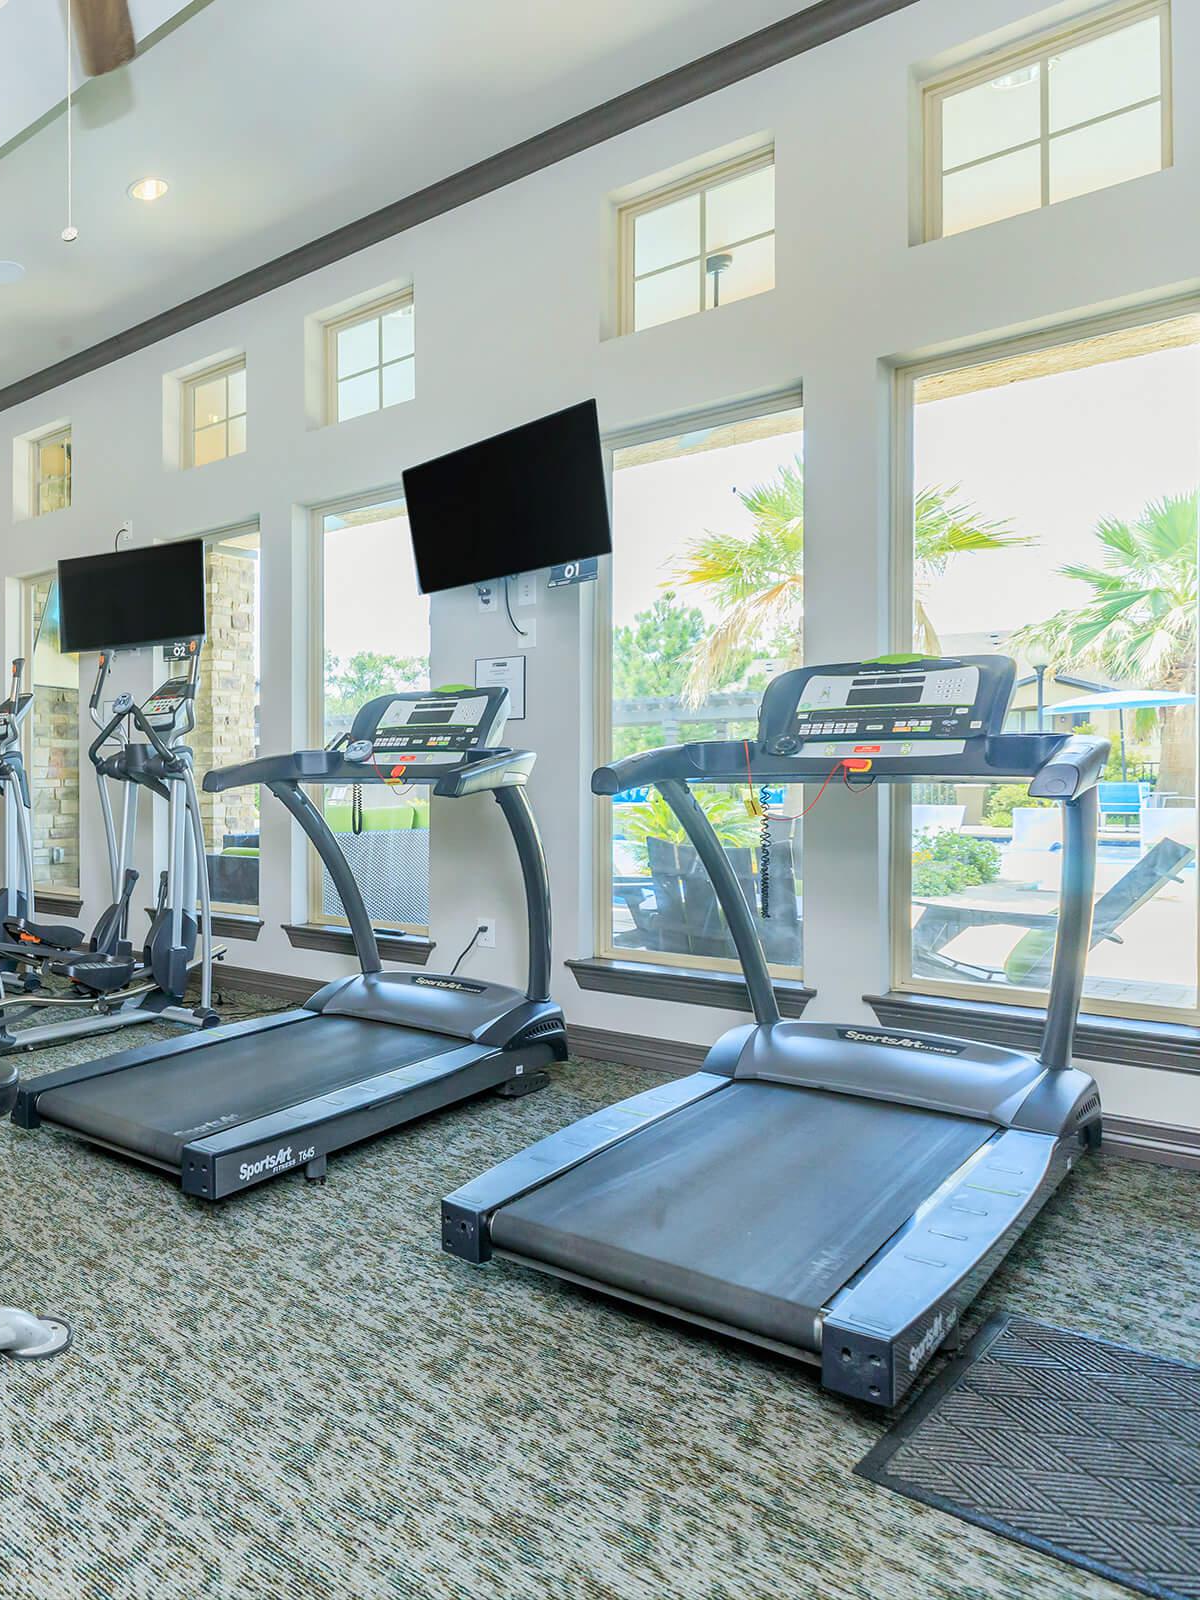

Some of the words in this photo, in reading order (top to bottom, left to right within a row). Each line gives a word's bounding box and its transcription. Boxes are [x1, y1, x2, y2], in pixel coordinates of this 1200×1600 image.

[565, 563, 579, 578] 01
[173, 646, 186, 656] 02
[845, 1030, 923, 1049] SportsArt
[239, 1146, 292, 1180] SportsArt
[272, 1158, 296, 1173] FITNESS
